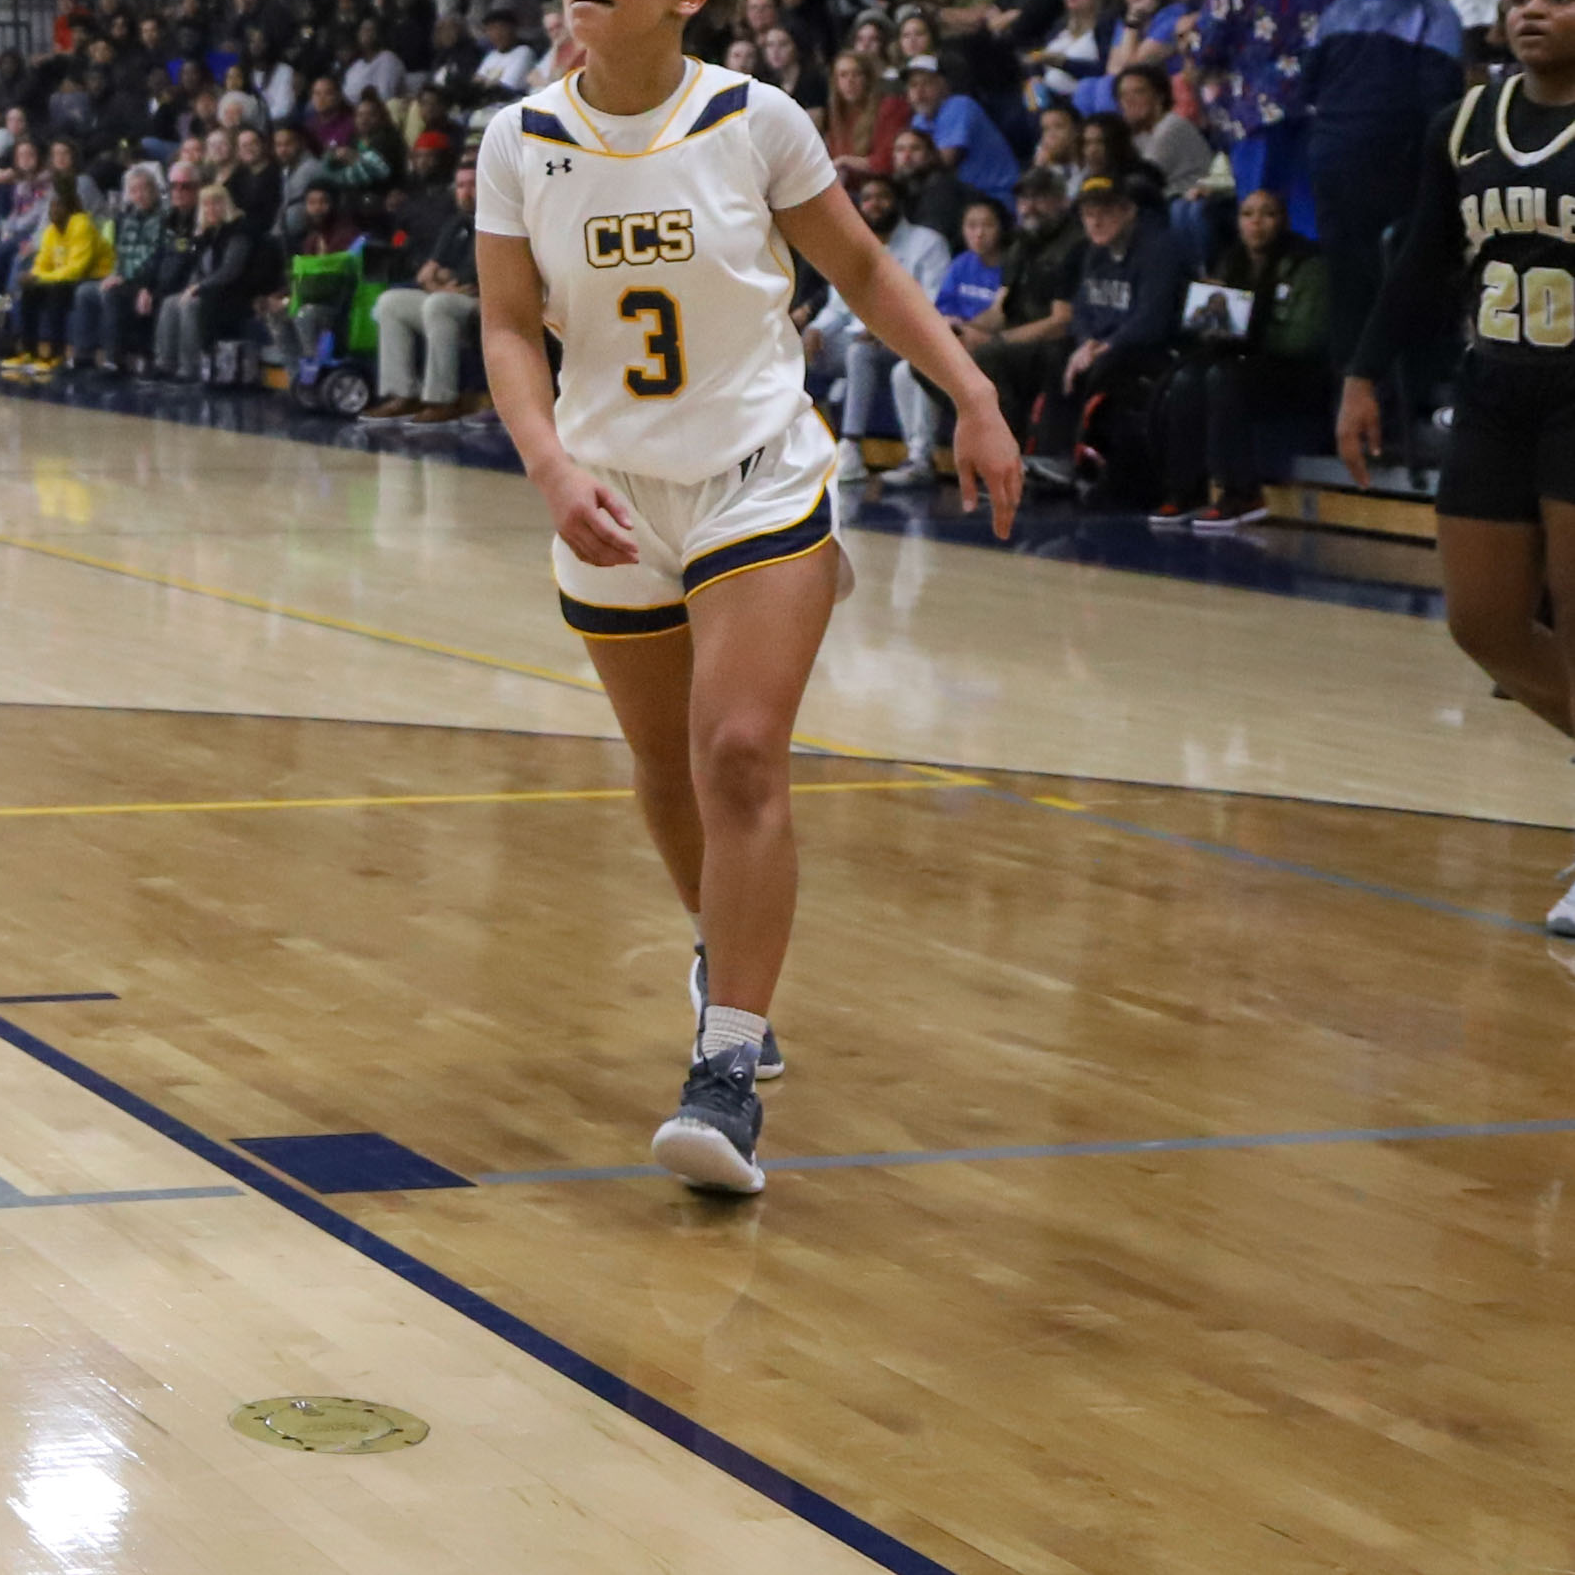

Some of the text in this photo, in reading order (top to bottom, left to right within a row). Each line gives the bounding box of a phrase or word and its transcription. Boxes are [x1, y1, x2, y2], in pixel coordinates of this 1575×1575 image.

[584, 209, 694, 269] CCS
[617, 285, 687, 401] 3
[1477, 260, 1575, 347] 20
